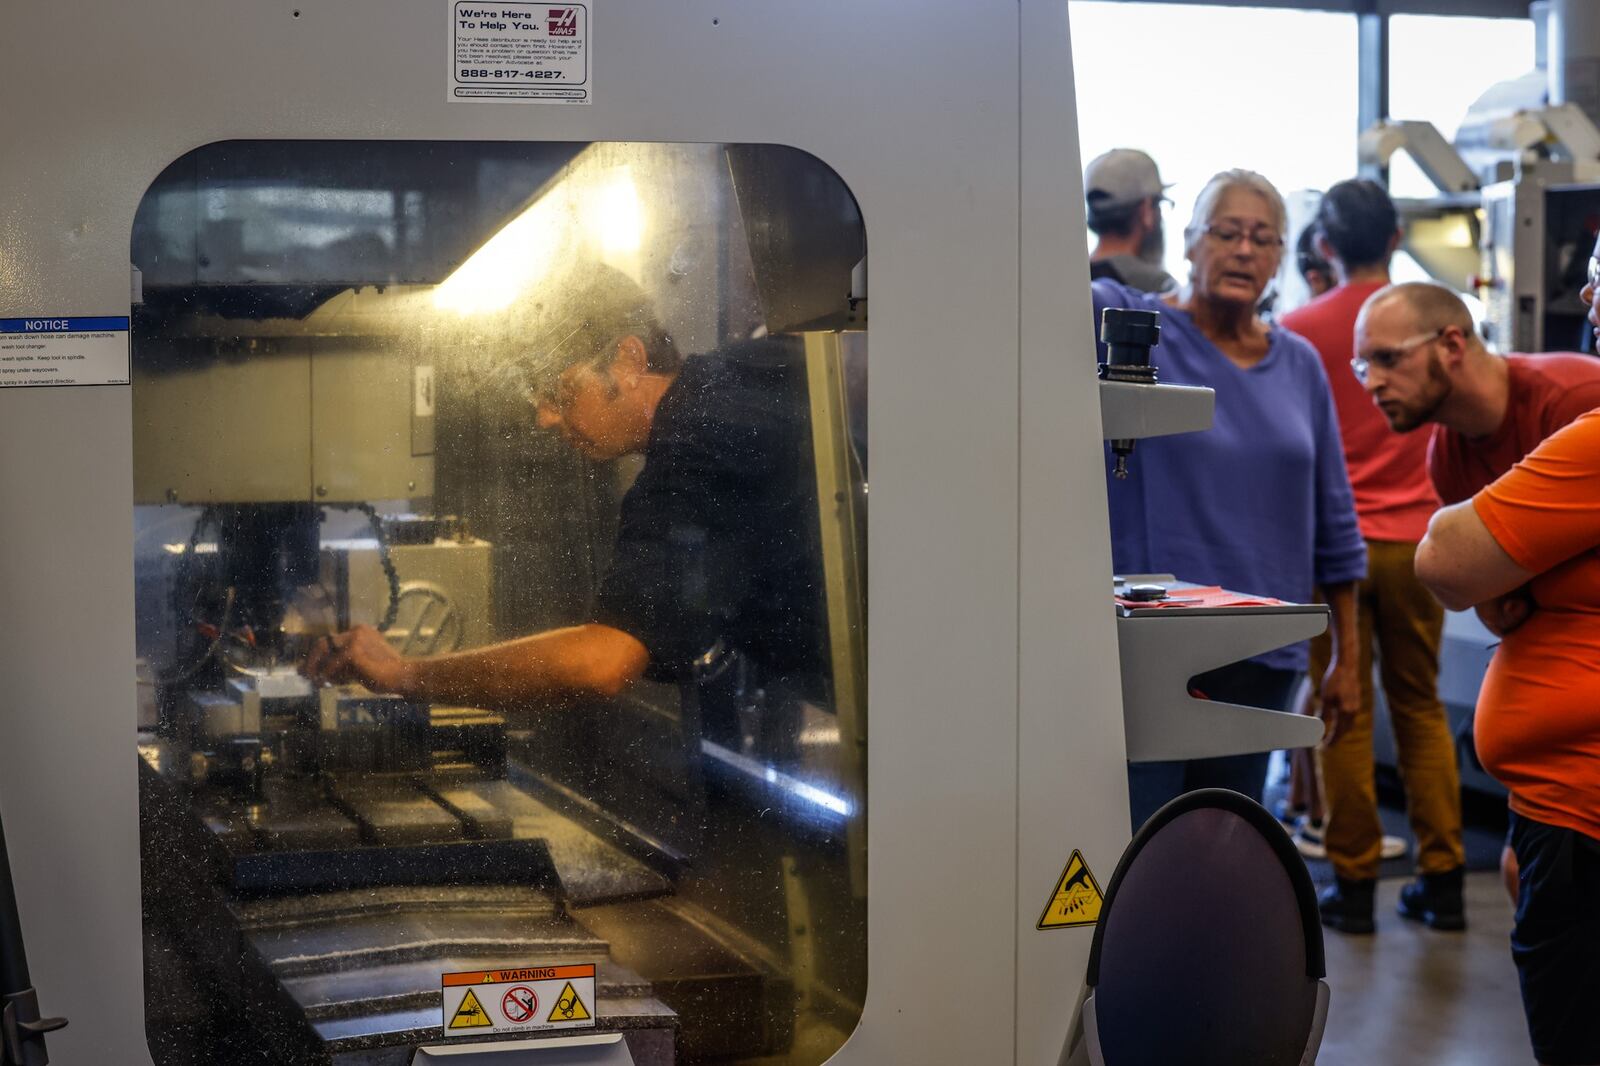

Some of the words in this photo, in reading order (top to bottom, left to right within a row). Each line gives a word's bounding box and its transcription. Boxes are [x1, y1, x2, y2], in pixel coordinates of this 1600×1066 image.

[460, 10, 497, 18] We're
[502, 11, 532, 19] Here
[460, 21, 476, 29] To
[480, 21, 507, 31] Help
[513, 22, 539, 30] You.
[549, 27, 576, 35] HAAS
[461, 70, 565, 79] 888-817-4227.
[26, 320, 68, 330] NOTICE
[500, 968, 556, 980] WARNING
